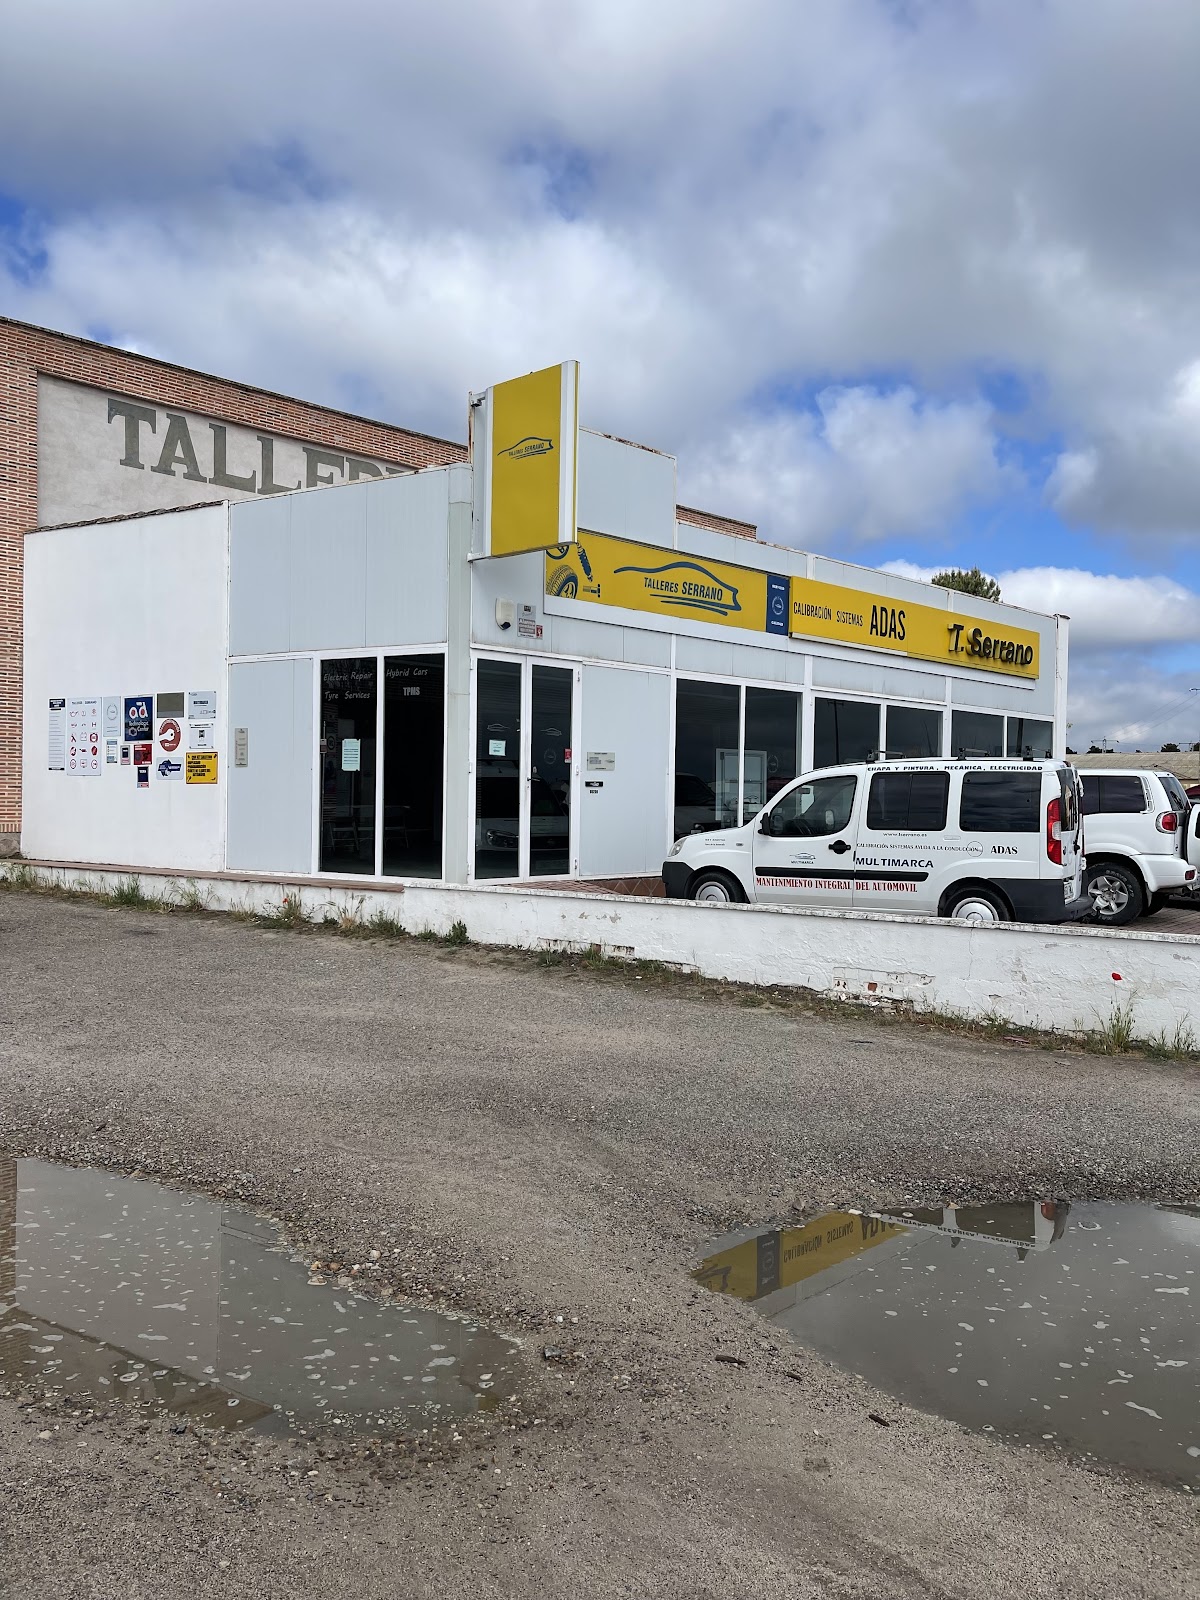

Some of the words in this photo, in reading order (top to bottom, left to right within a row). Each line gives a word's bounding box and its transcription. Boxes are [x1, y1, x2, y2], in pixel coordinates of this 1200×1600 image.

[524, 442, 545, 453] SERRANO
[644, 577, 679, 593] TALLERES
[681, 581, 723, 601] SERRANO
[793, 601, 832, 620] CALIBRACIÓN
[836, 610, 864, 627] SISTEMAS
[869, 604, 906, 641] ADAS
[323, 672, 349, 681] Electric
[350, 671, 373, 682] Repair
[386, 668, 410, 679] Hybrid
[413, 667, 428, 676] Cars
[324, 691, 339, 701] Tyre
[344, 690, 371, 699] Services
[990, 845, 1018, 855] ADAS
[855, 857, 935, 869] MULTIMARCA
[756, 877, 813, 889] MANTENIMIENTO
[815, 879, 852, 890] INTEGRAL
[855, 881, 871, 891] DEL
[872, 882, 918, 893] AUTOMOVIL
